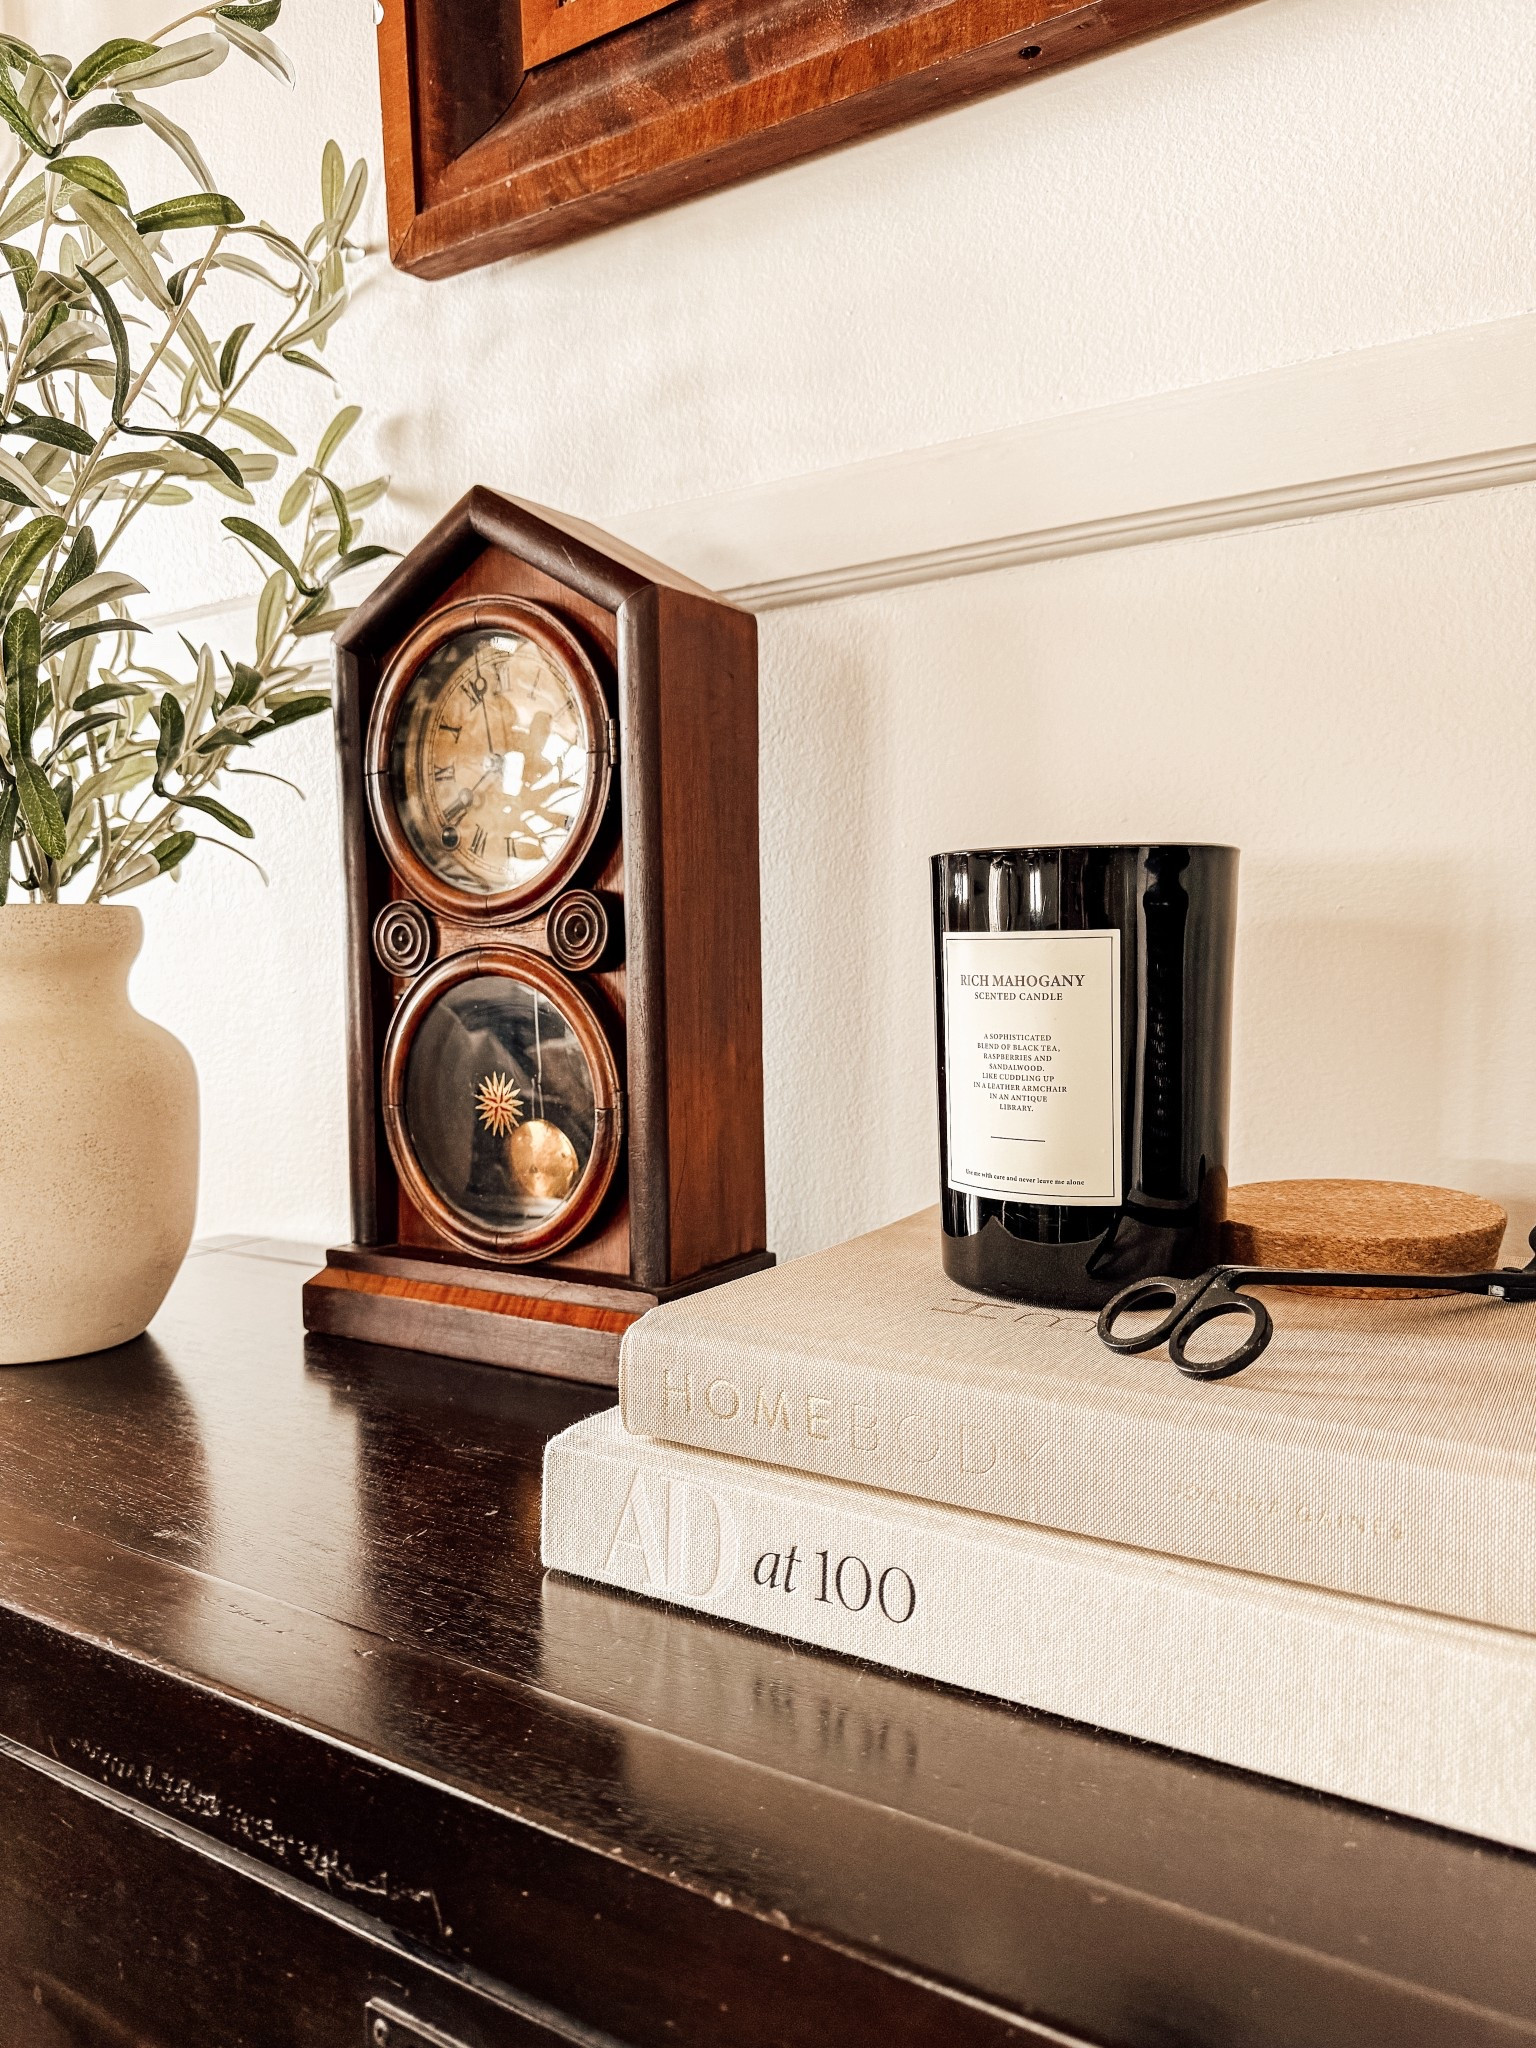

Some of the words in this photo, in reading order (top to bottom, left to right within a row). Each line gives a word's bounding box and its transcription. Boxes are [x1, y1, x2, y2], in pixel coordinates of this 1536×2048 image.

[960, 974, 989, 987] RICH
[992, 974, 1086, 988] MAHOGANY
[974, 991, 1017, 1001] SCENTED
[1018, 992, 1064, 1001] CANDLE
[989, 1033, 1052, 1042] SOPHISTICATED
[977, 1042, 1000, 1050] BLEND
[1000, 1043, 1011, 1051] OF
[1012, 1043, 1040, 1052] BLACK
[1040, 1044, 1061, 1053] TEA,
[983, 1052, 1032, 1062] RASPBERRIES
[1033, 1054, 1052, 1062] AND
[989, 1062, 1045, 1072] SANDALWOOD.
[982, 1072, 998, 1080] LIKE
[998, 1073, 1041, 1082] CUDDLING
[1043, 1075, 1055, 1083] UP
[973, 1081, 981, 1089] IN
[987, 1083, 1021, 1091] LEATHER
[1021, 1085, 1068, 1093] ARMCHAIR
[989, 1092, 998, 1100] IN
[998, 1093, 1010, 1101] AN
[1010, 1094, 1048, 1104] ANTIQUE
[999, 1103, 1034, 1112] LIBRARY.
[1037, 1177, 1054, 1185] leave
[603, 1468, 738, 1602] AD
[752, 1545, 803, 1594] at
[815, 1549, 916, 1625] 100
